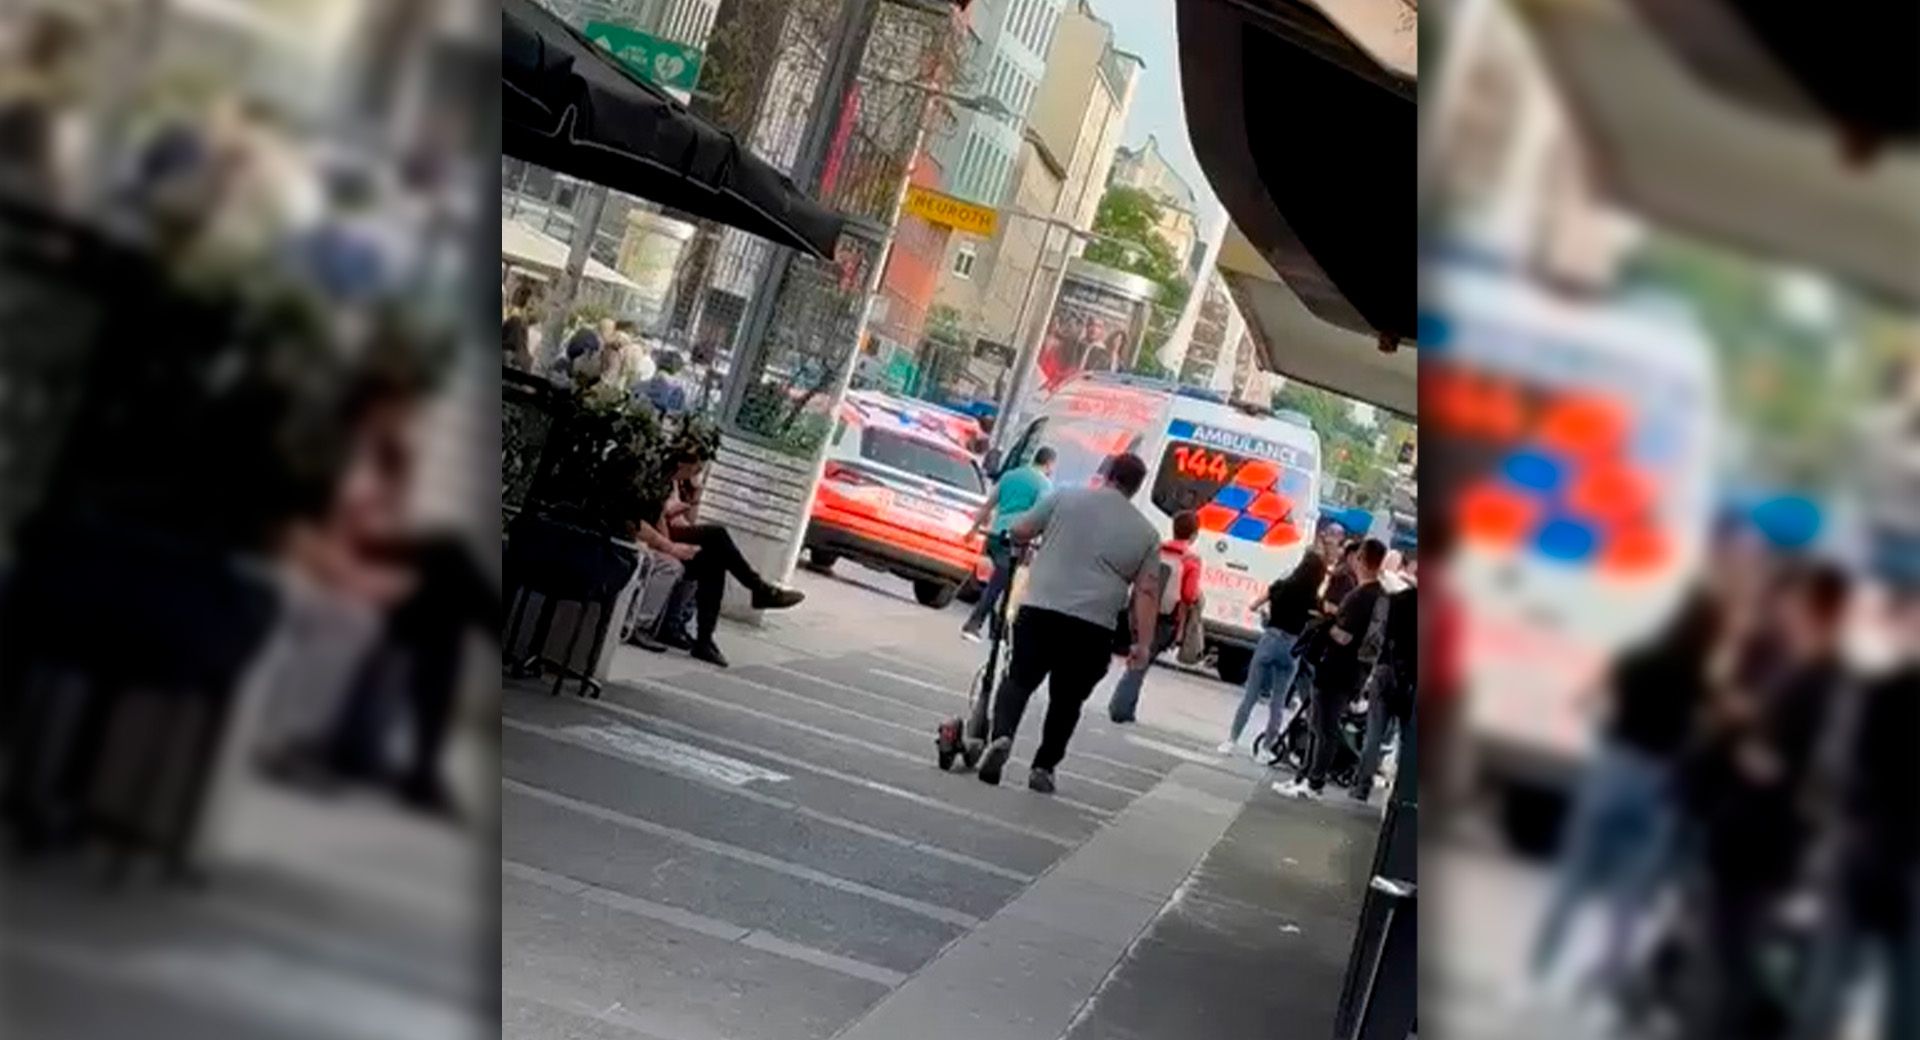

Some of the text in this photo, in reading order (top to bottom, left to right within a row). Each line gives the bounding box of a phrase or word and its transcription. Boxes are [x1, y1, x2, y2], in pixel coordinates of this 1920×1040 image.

[914, 194, 990, 226] NEUROTH
[1173, 446, 1229, 483] 144
[1191, 425, 1298, 467] AMBULANCE
